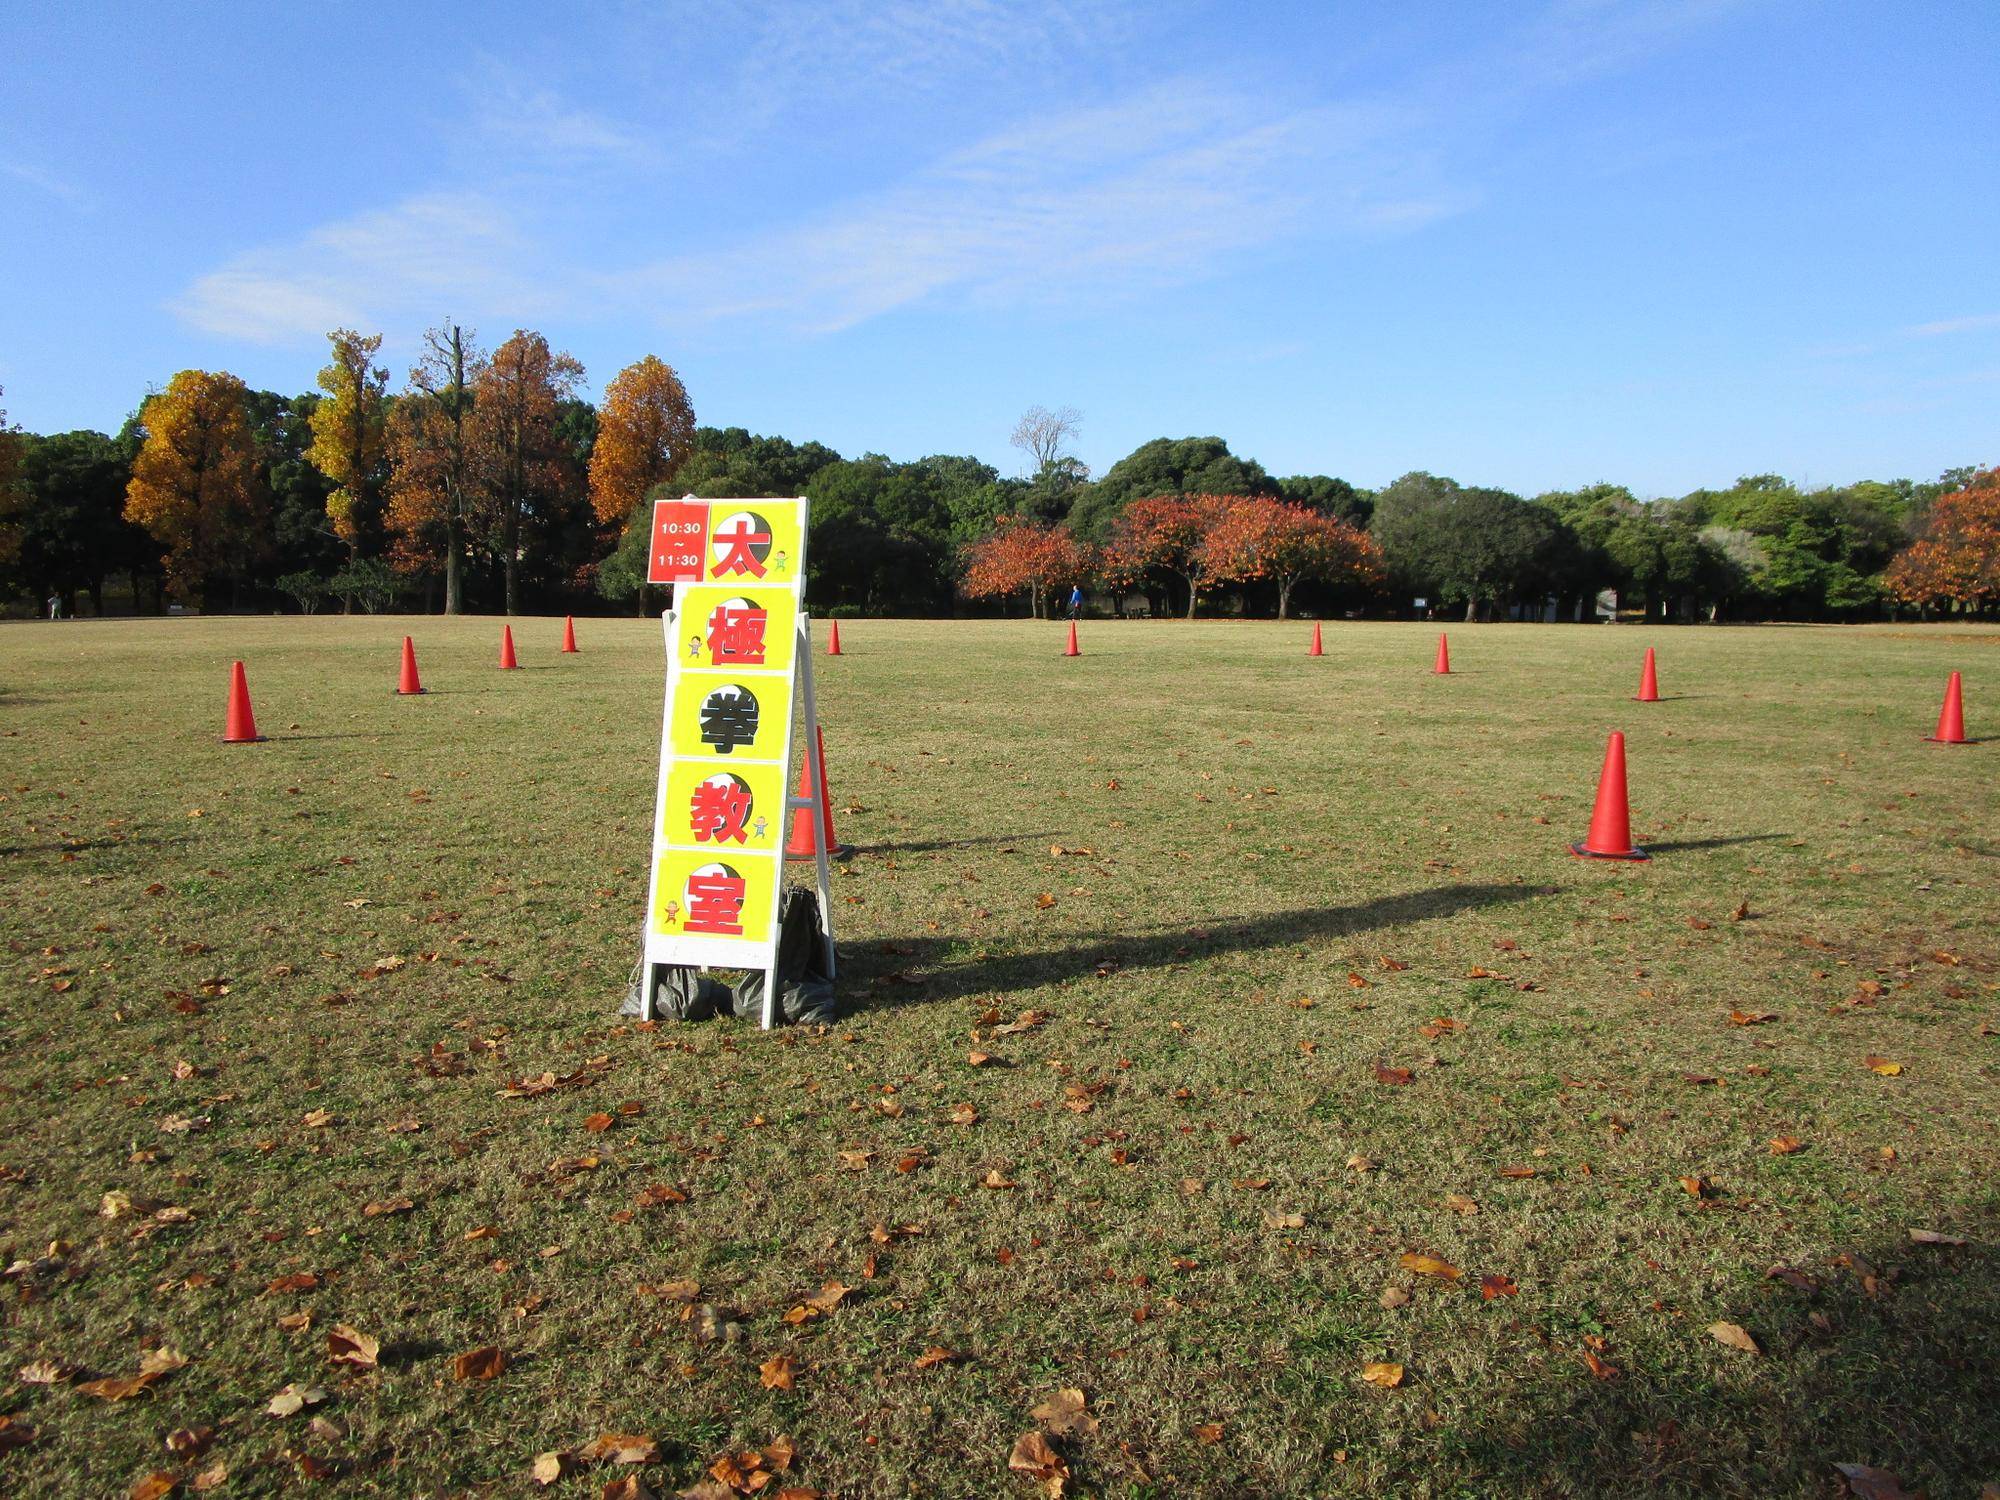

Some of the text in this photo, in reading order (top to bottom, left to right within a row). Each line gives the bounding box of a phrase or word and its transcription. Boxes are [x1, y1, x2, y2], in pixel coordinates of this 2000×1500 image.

[662, 523, 701, 534] 10:30
[659, 555, 698, 566] 11:30
[683, 521, 770, 935] 太極拳教室
